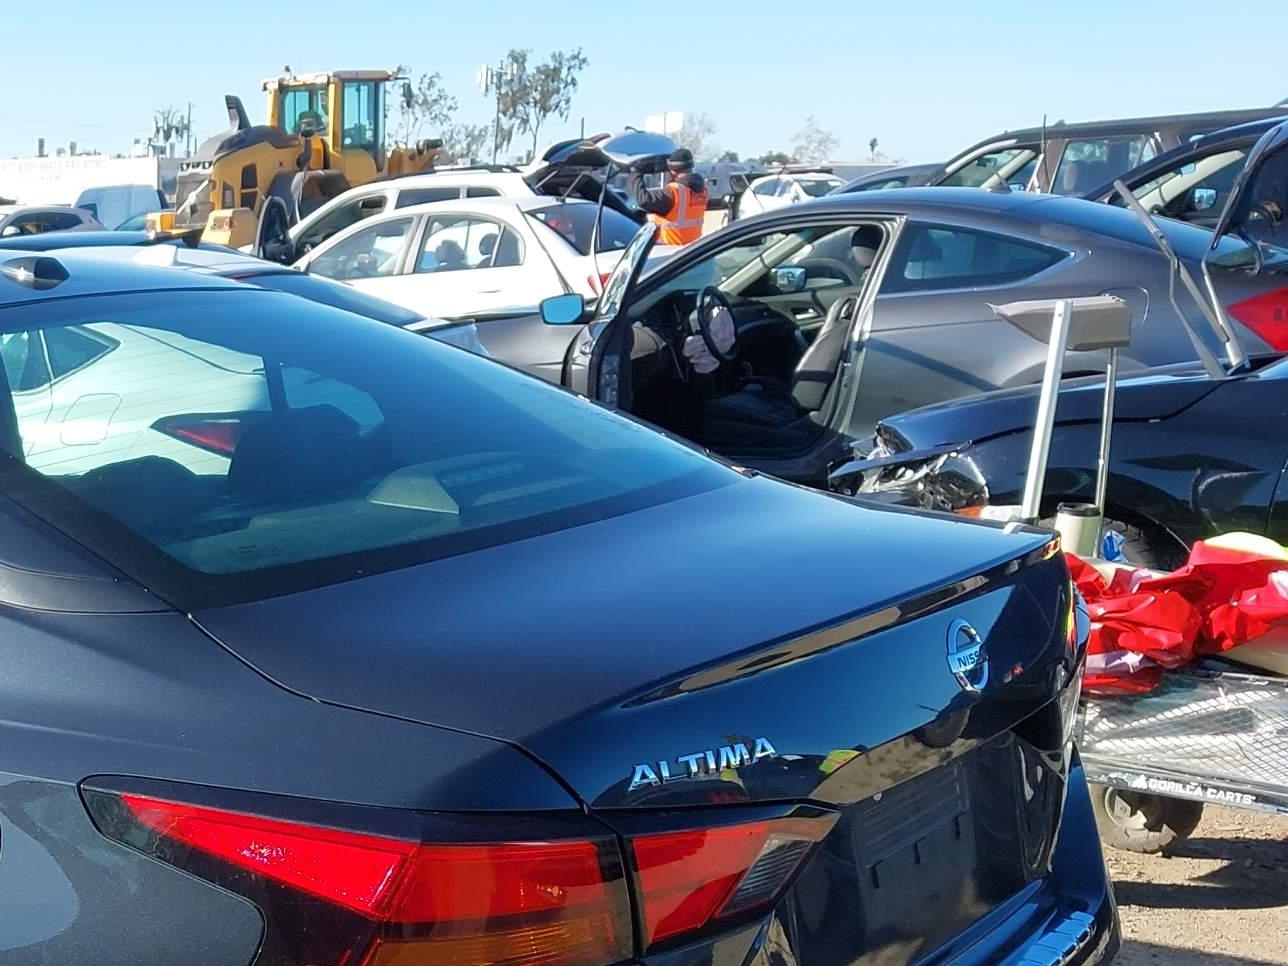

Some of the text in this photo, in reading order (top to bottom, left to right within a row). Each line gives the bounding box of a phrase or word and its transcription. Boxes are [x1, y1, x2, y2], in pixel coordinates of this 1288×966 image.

[956, 648, 983, 668] NISS
[628, 736, 777, 792] ALTIMA
[1148, 778, 1255, 805] GORILLA CARTS
